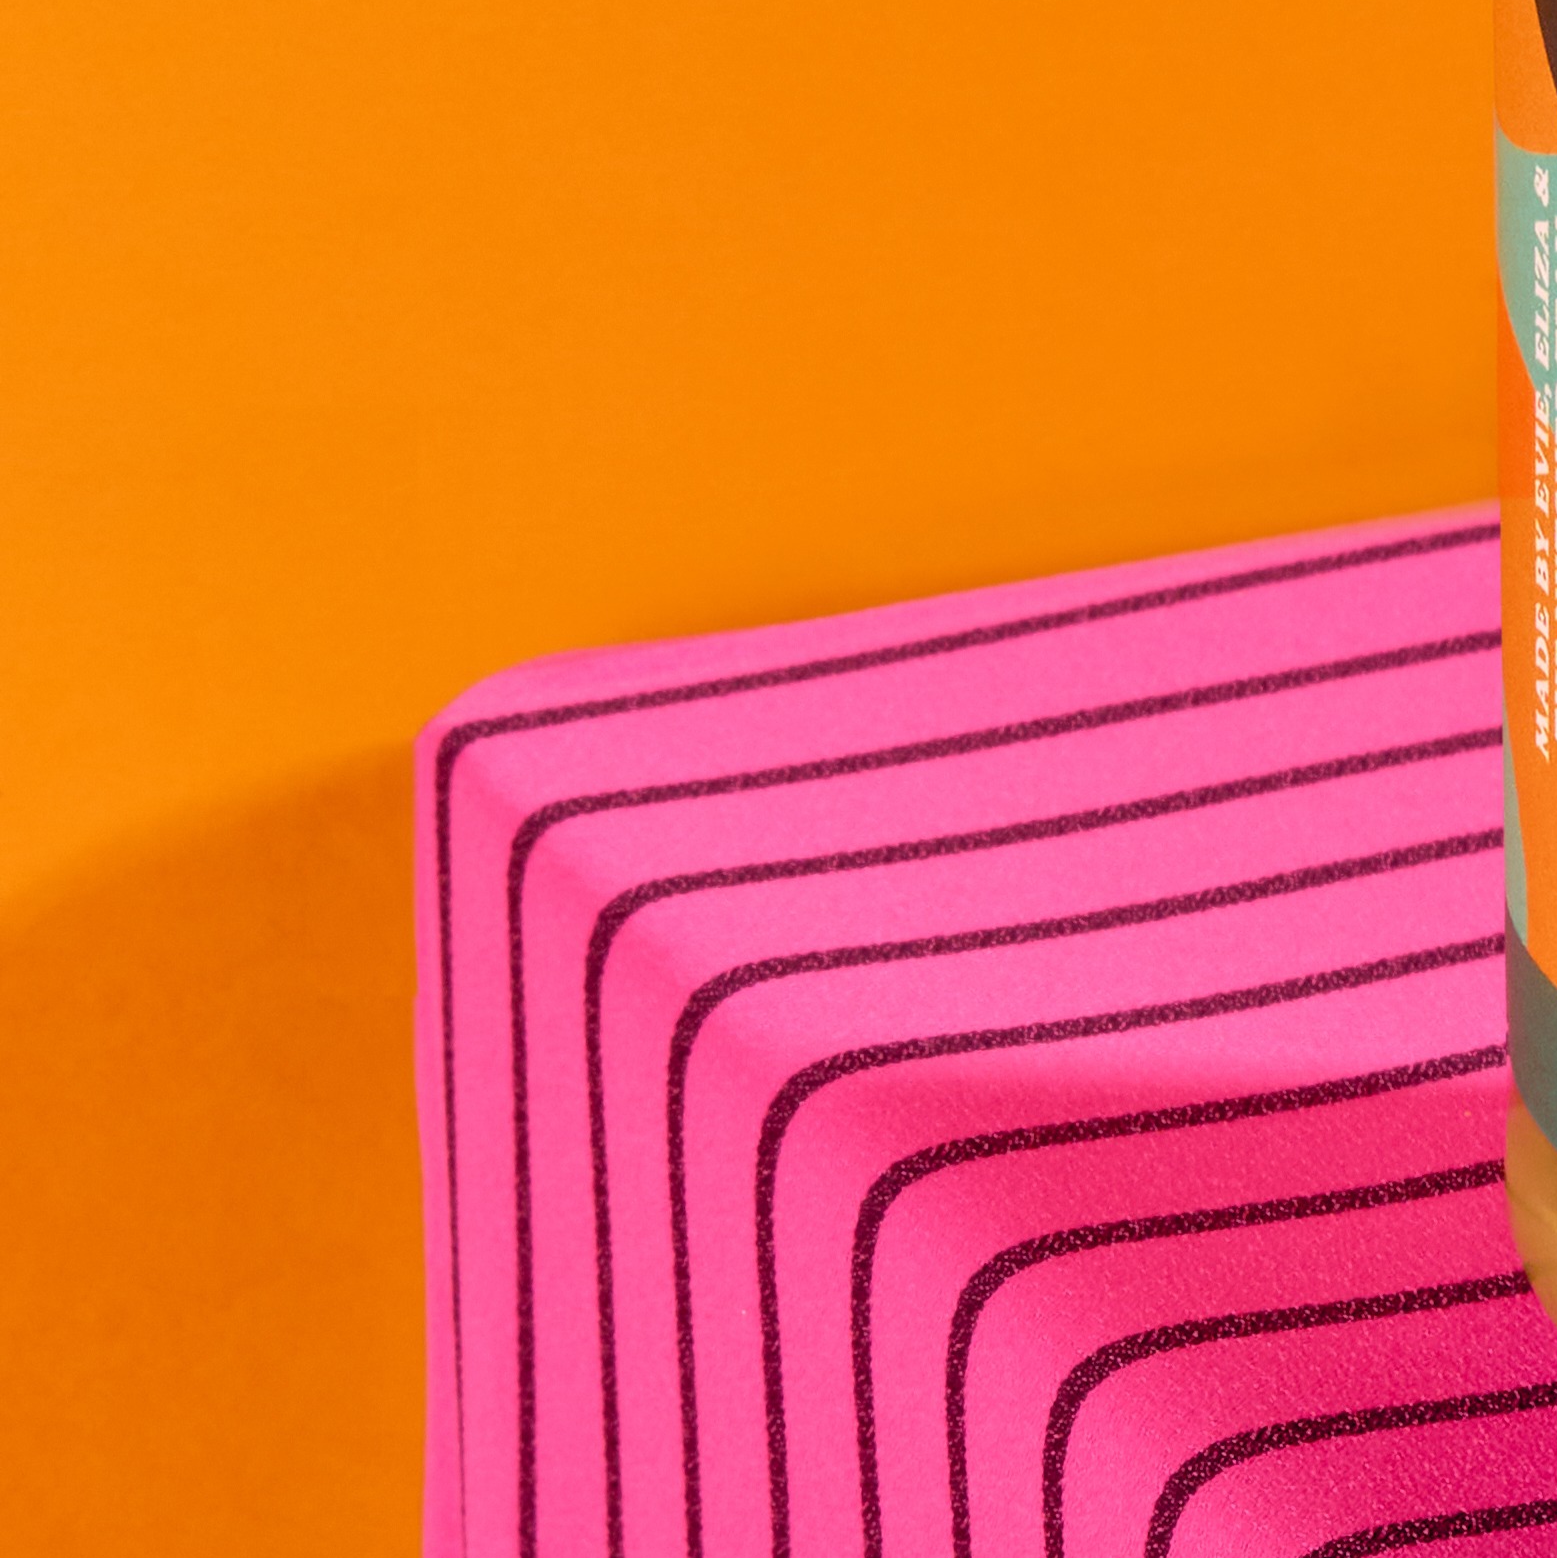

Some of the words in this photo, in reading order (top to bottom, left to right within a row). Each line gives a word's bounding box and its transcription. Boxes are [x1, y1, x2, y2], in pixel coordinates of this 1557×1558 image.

[1534, 165, 1550, 207] &
[1534, 220, 1550, 370] ELIZA
[1534, 383, 1552, 517] EVIE,
[1534, 518, 1550, 596] BY
[1534, 603, 1550, 764] MADE
